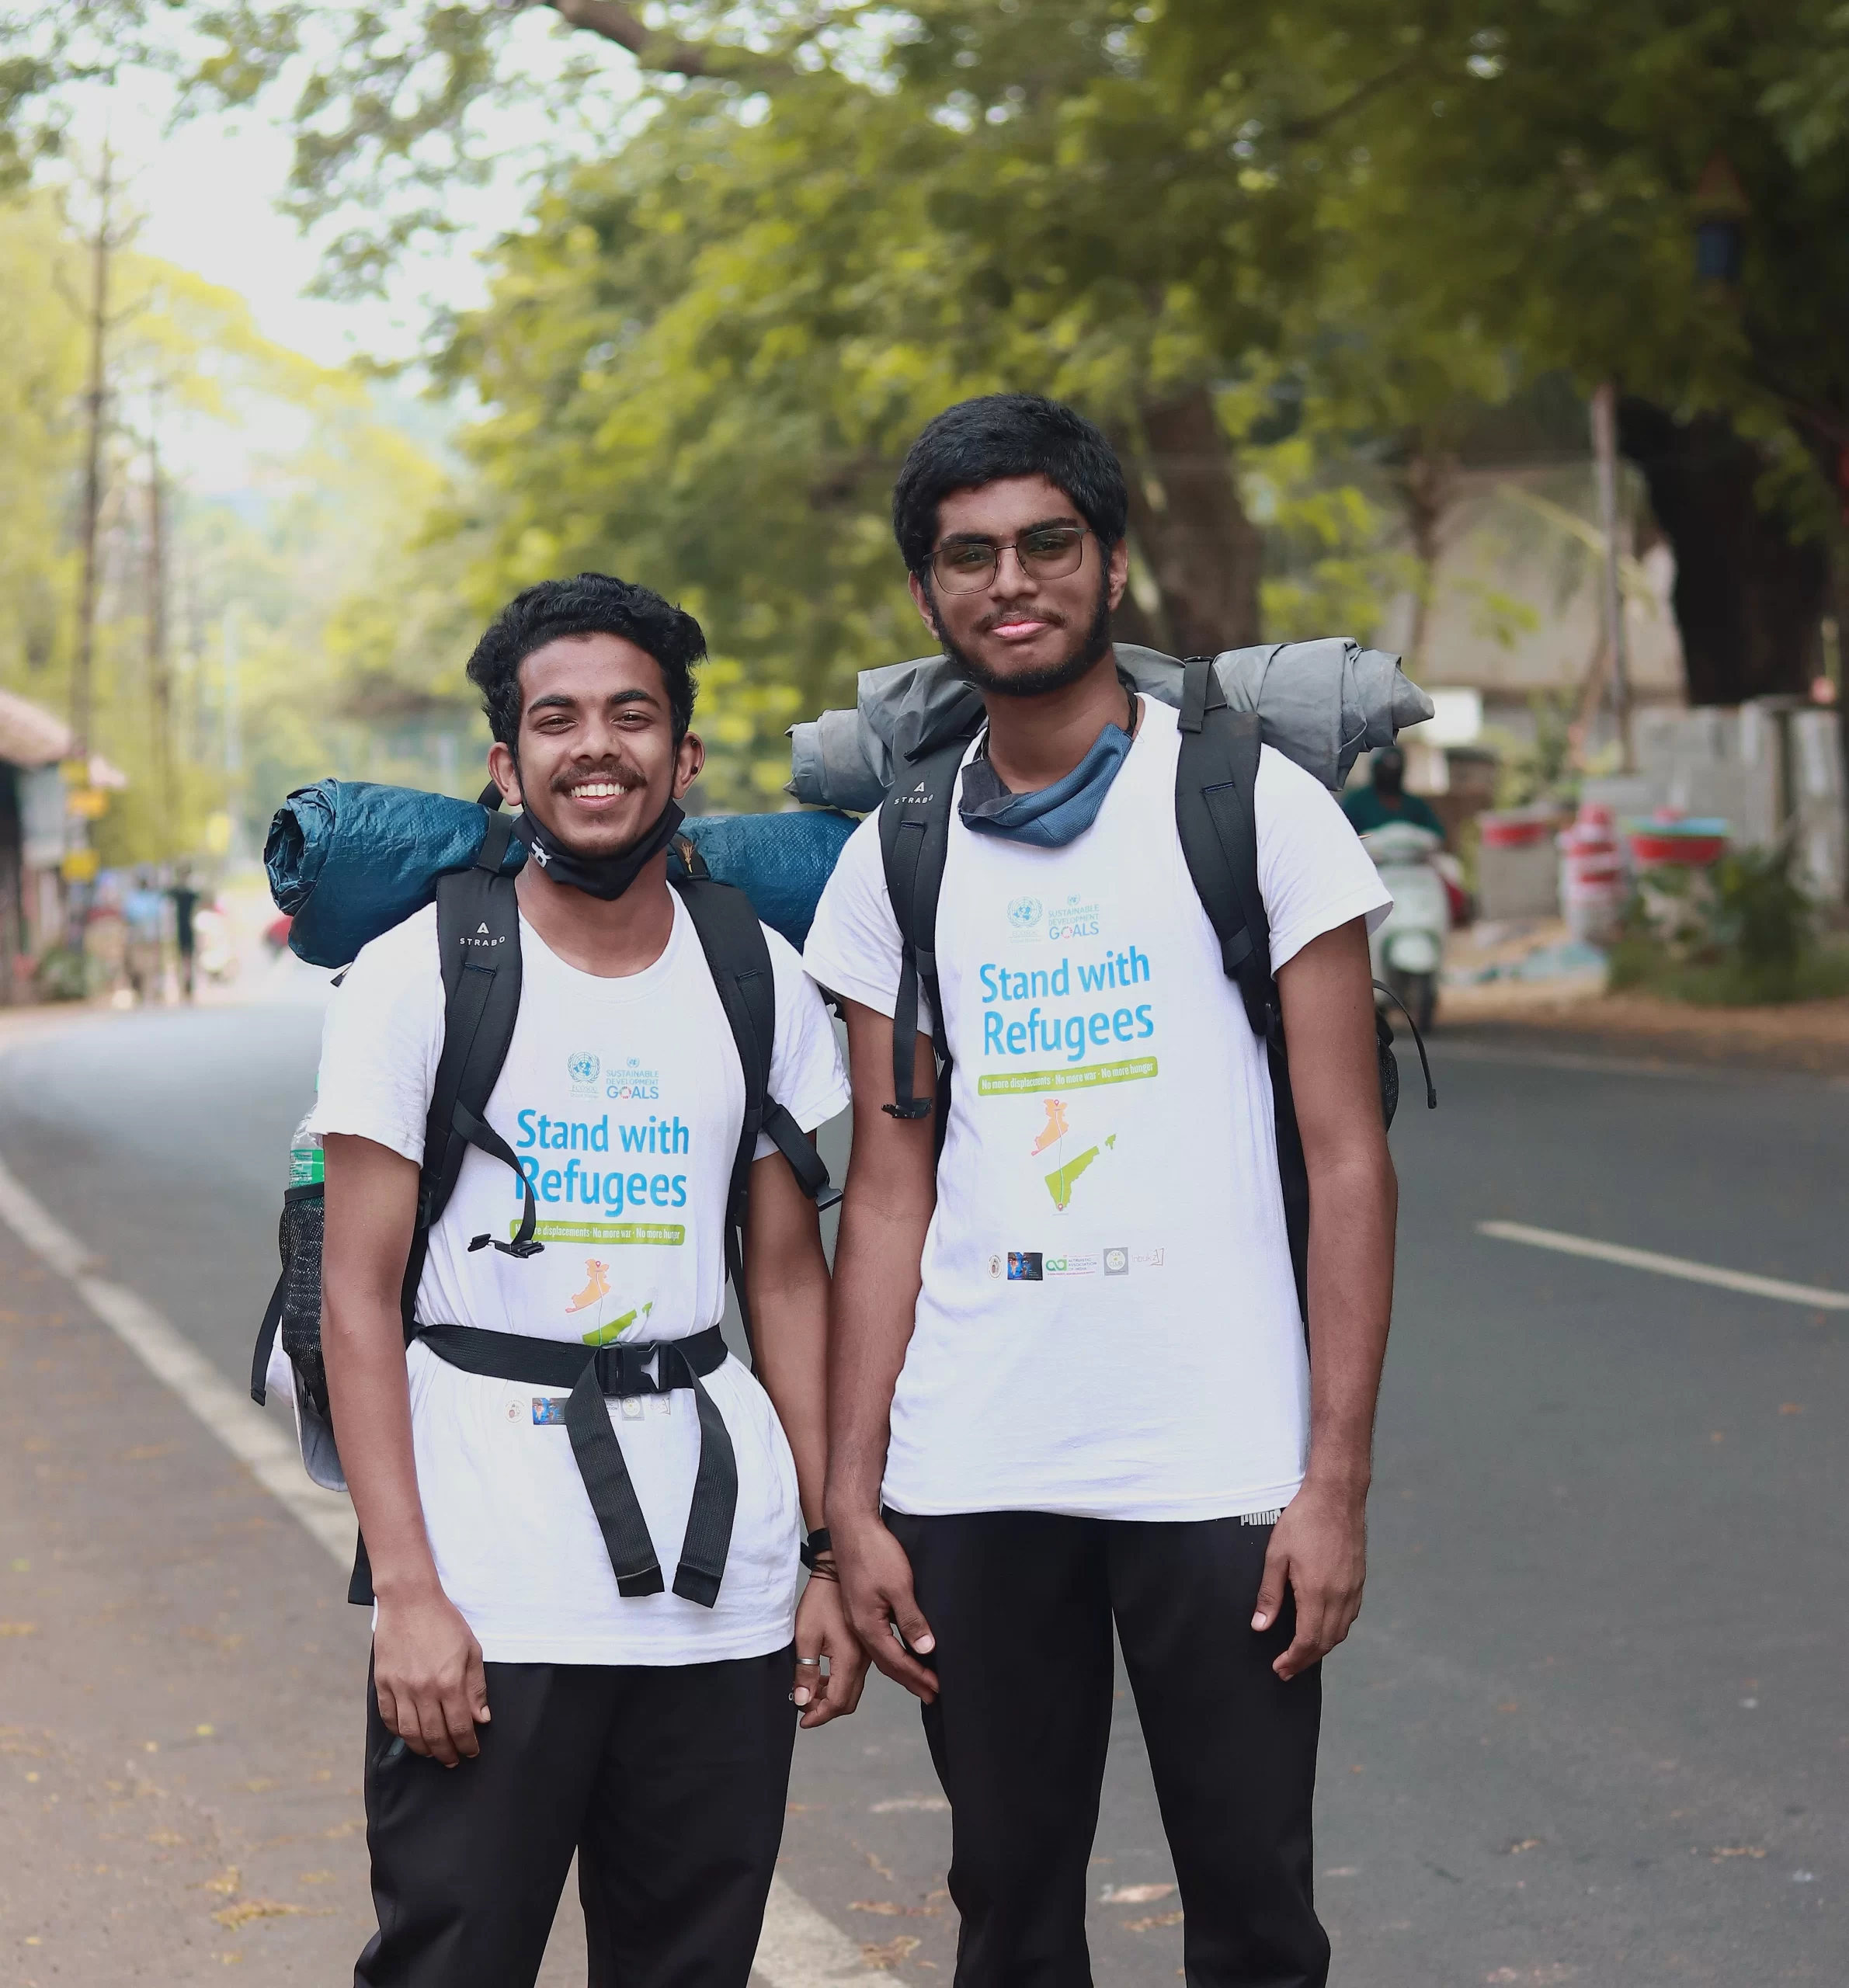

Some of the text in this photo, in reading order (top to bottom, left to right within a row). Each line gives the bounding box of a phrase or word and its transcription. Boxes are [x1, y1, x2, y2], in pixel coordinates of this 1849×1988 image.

[894, 794, 933, 805] STRABO
[1048, 904, 1100, 918] SUSTAINABLE
[1048, 913, 1100, 926] DEVELOPMENT
[1049, 921, 1100, 940] GOALS
[459, 936, 506, 946] STRABO
[979, 945, 1150, 1003] Stand with
[984, 1004, 1154, 1062] Refugees
[982, 1079, 991, 1090] No
[992, 1079, 1009, 1089] more
[1055, 1074, 1065, 1085] No
[1066, 1074, 1083, 1084] more
[1084, 1071, 1097, 1081] war
[1101, 1068, 1112, 1078] No
[1113, 1066, 1130, 1077] more
[1130, 1062, 1154, 1075] hunger
[606, 1086, 659, 1100] GOALS
[516, 1109, 690, 1155] Stand with
[516, 1156, 687, 1218] Refugees
[593, 1227, 602, 1238] No
[603, 1229, 620, 1238] more
[620, 1229, 631, 1238] war
[636, 1227, 645, 1238] No
[646, 1230, 662, 1239] more
